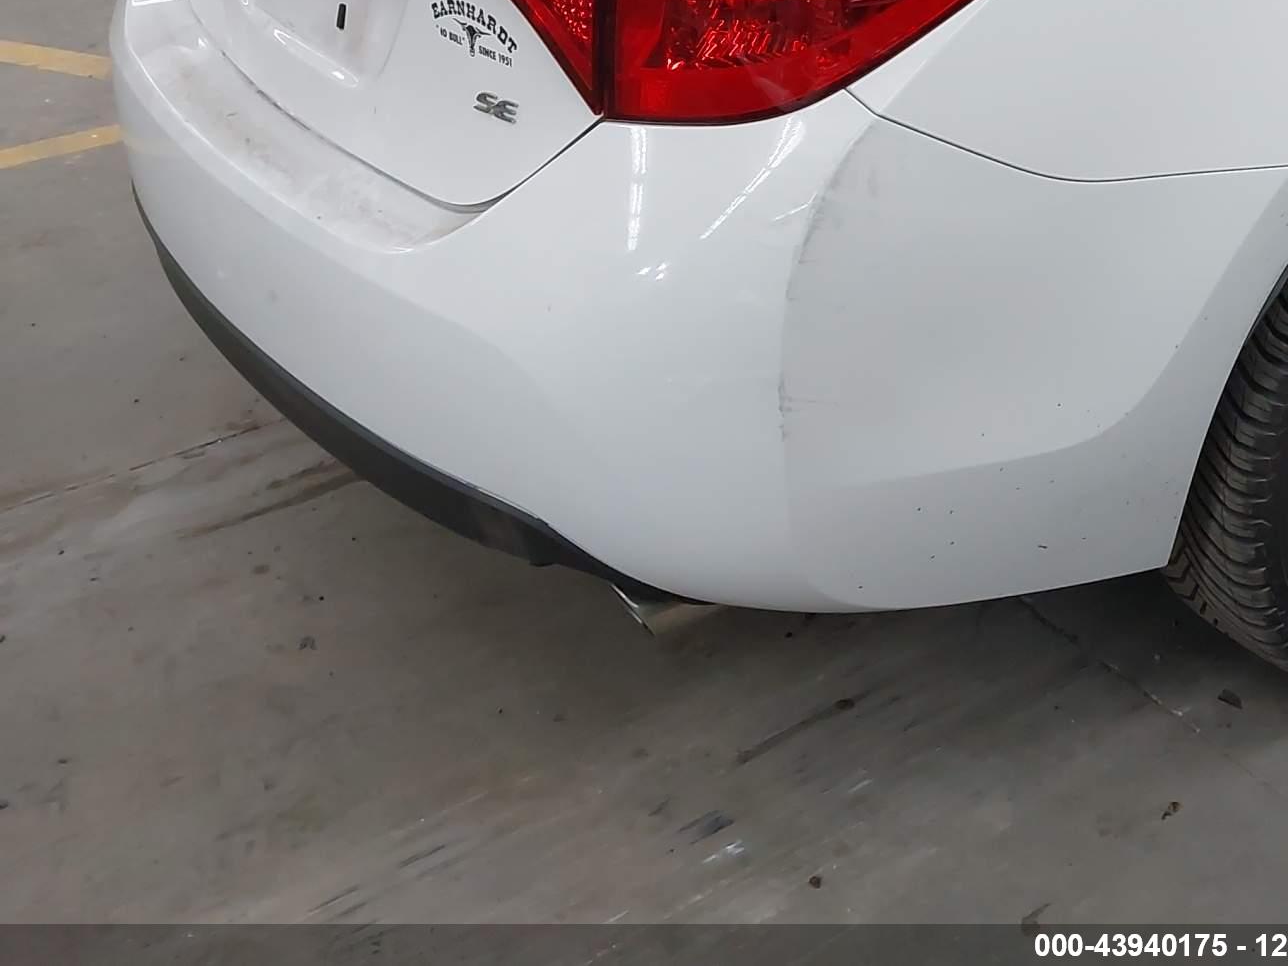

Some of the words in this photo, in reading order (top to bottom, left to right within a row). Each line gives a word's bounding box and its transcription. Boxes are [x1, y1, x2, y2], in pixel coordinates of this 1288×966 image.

[432, 0, 518, 53] EARNHARDT
[478, 45, 497, 61] SINCE
[498, 53, 513, 68] 1951
[473, 91, 519, 125] SE
